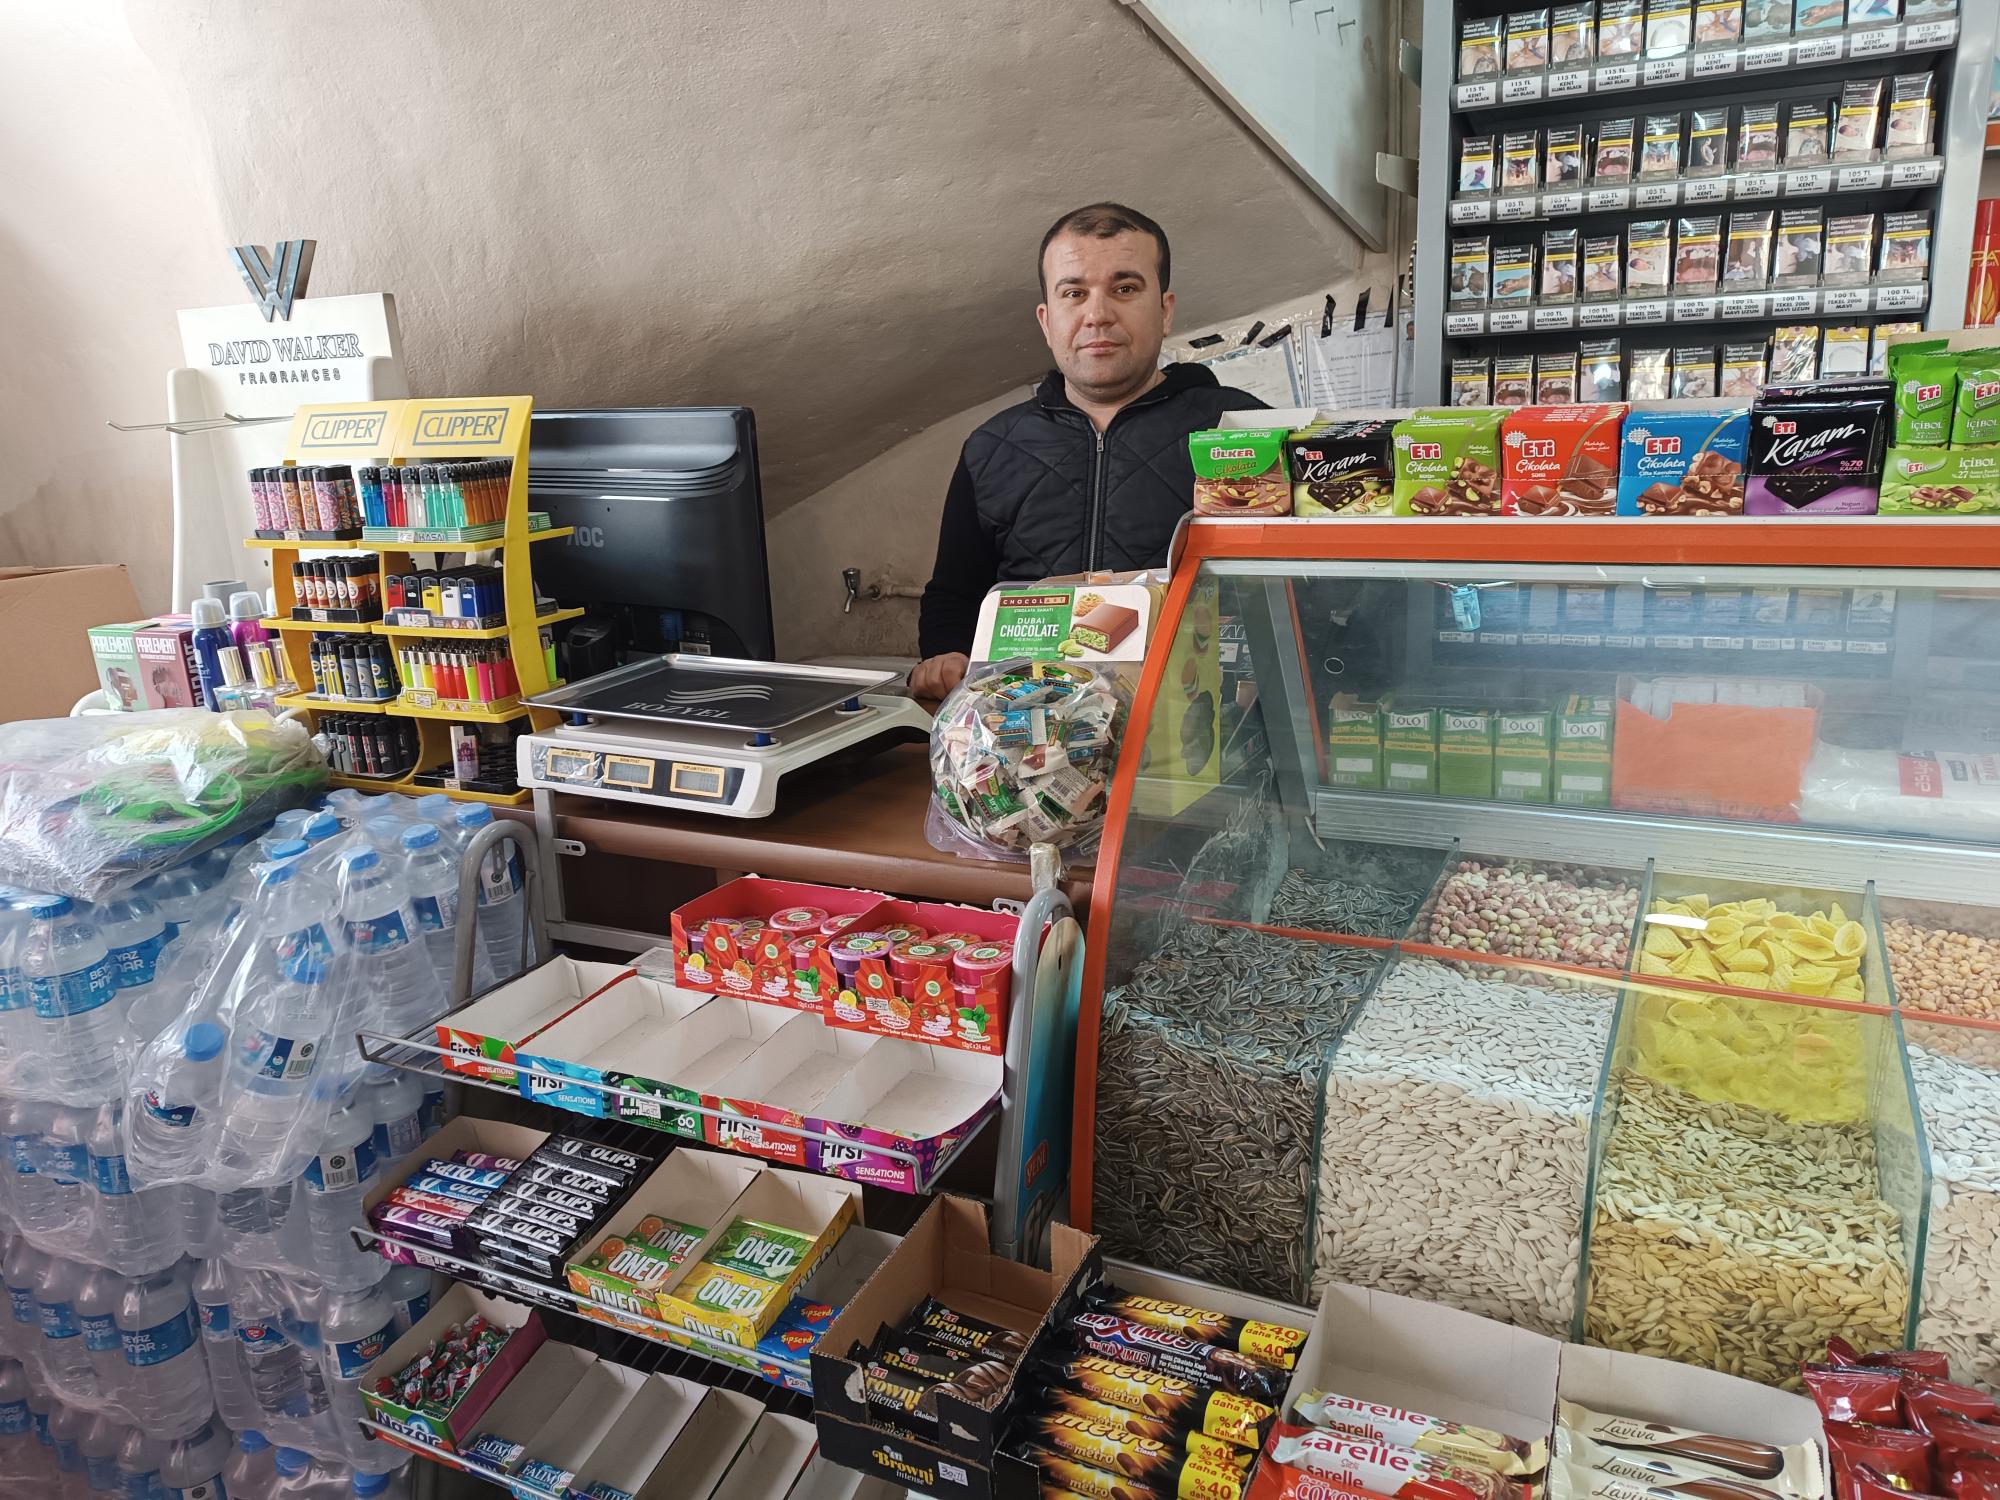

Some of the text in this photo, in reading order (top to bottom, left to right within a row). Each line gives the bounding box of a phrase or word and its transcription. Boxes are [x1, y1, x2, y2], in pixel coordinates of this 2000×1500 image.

[208, 333, 363, 367] DAVID WALKER
[239, 368, 341, 385] FRAGRANCES
[310, 419, 376, 441] CLIPPER
[423, 415, 498, 437] CLIPPER
[1210, 447, 1255, 459] ÜLKER
[1762, 424, 1865, 466] Karam
[1213, 460, 1257, 476] Çikolata
[1302, 451, 1376, 482] Karam
[1406, 461, 1448, 474] Çikolata
[1516, 459, 1560, 473] Çikolata
[1638, 457, 1686, 470] Çikolata
[1000, 624, 1059, 637] CHOCOLATE
[91, 636, 133, 654] PARLEMENT
[135, 637, 176, 655] PARLEMENT
[622, 701, 730, 719] BOZYEL
[478, 1065, 514, 1076] SENSATIONS
[558, 1094, 596, 1105] SENSATIONS
[678, 1115, 695, 1128] 60
[855, 1166, 905, 1179] SENSATIONS
[735, 1236, 796, 1268] ONEO
[608, 1249, 669, 1282] ONEO
[698, 1276, 760, 1311] ONEO
[1127, 1296, 1225, 1322] metro
[923, 1313, 992, 1348] Browni
[936, 1329, 972, 1347] intense
[1080, 1313, 1193, 1350] MAXIMUS
[1082, 1356, 1189, 1390] metro
[1326, 1396, 1428, 1426] sarelle
[1054, 1412, 1164, 1451] metro
[1329, 1419, 1384, 1441] sarelle
[1593, 1418, 1658, 1443] Laviva
[1301, 1435, 1410, 1471] sarelle
[522, 1465, 556, 1484] FALIM
[872, 1450, 934, 1485] Browni
[1306, 1463, 1364, 1489] sarelle
[1593, 1456, 1659, 1485] Laviva
